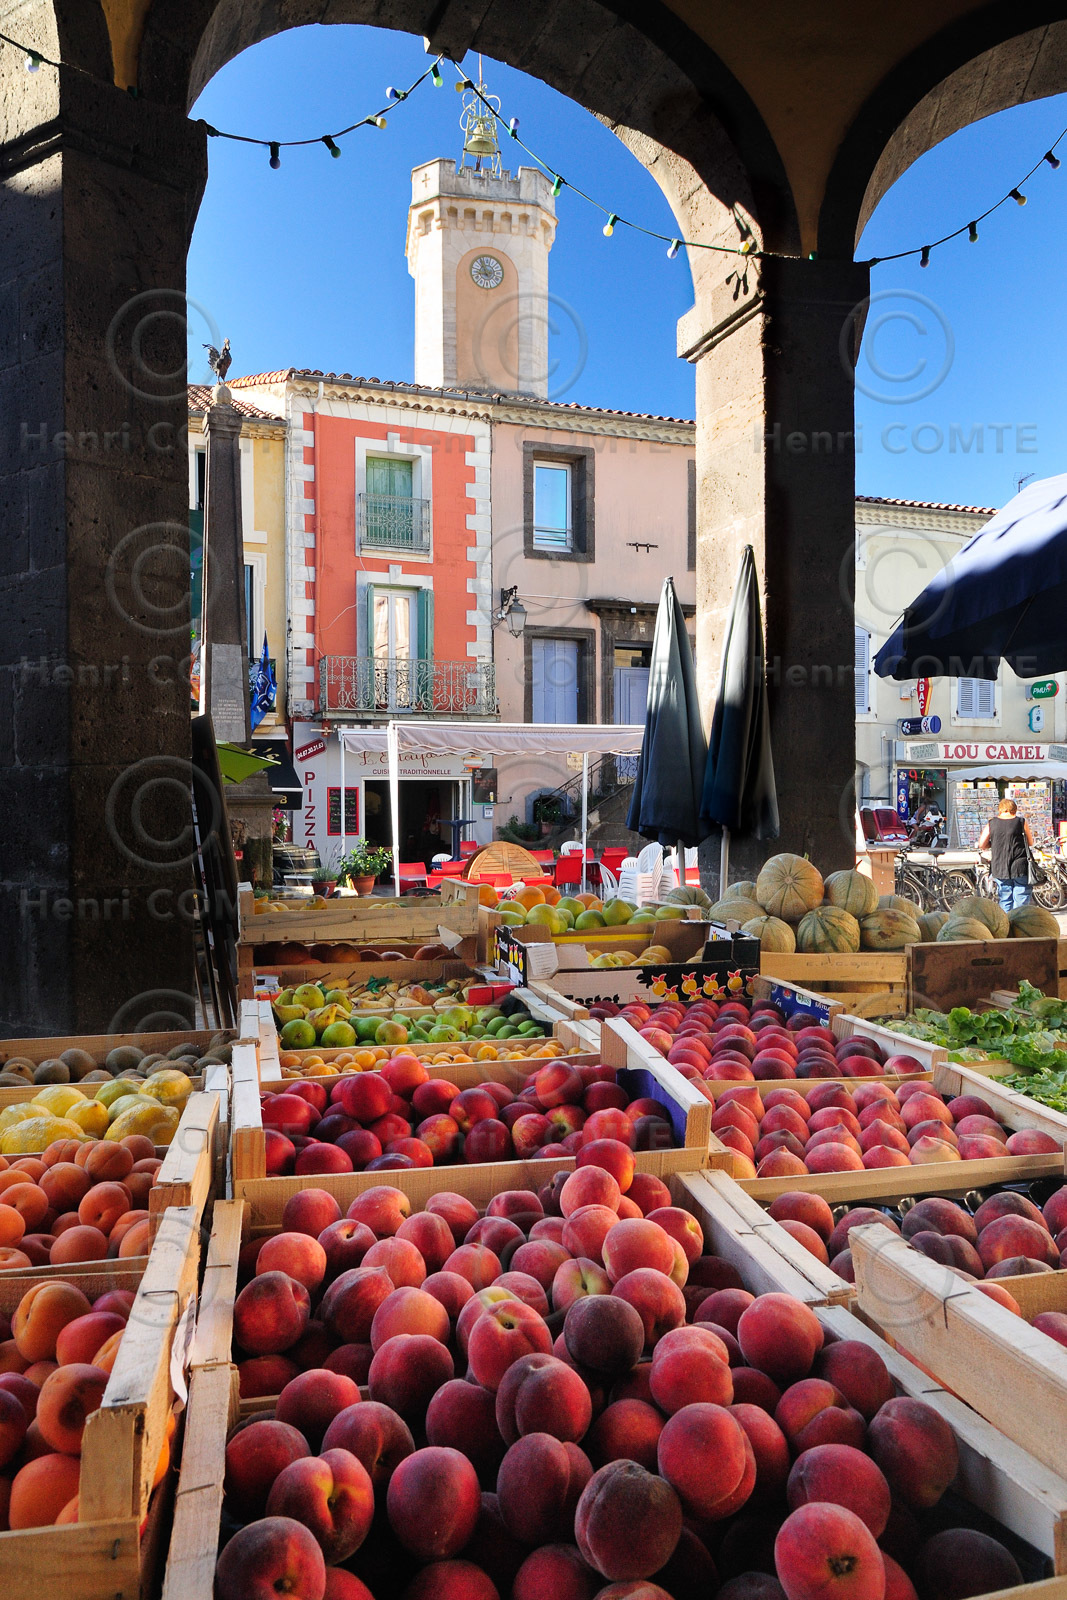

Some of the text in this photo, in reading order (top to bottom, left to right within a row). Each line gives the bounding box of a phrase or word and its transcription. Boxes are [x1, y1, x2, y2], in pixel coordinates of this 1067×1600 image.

[943, 744, 979, 759] LOU
[985, 744, 1045, 760] CAMEL
[304, 771, 316, 851] PIZZA
